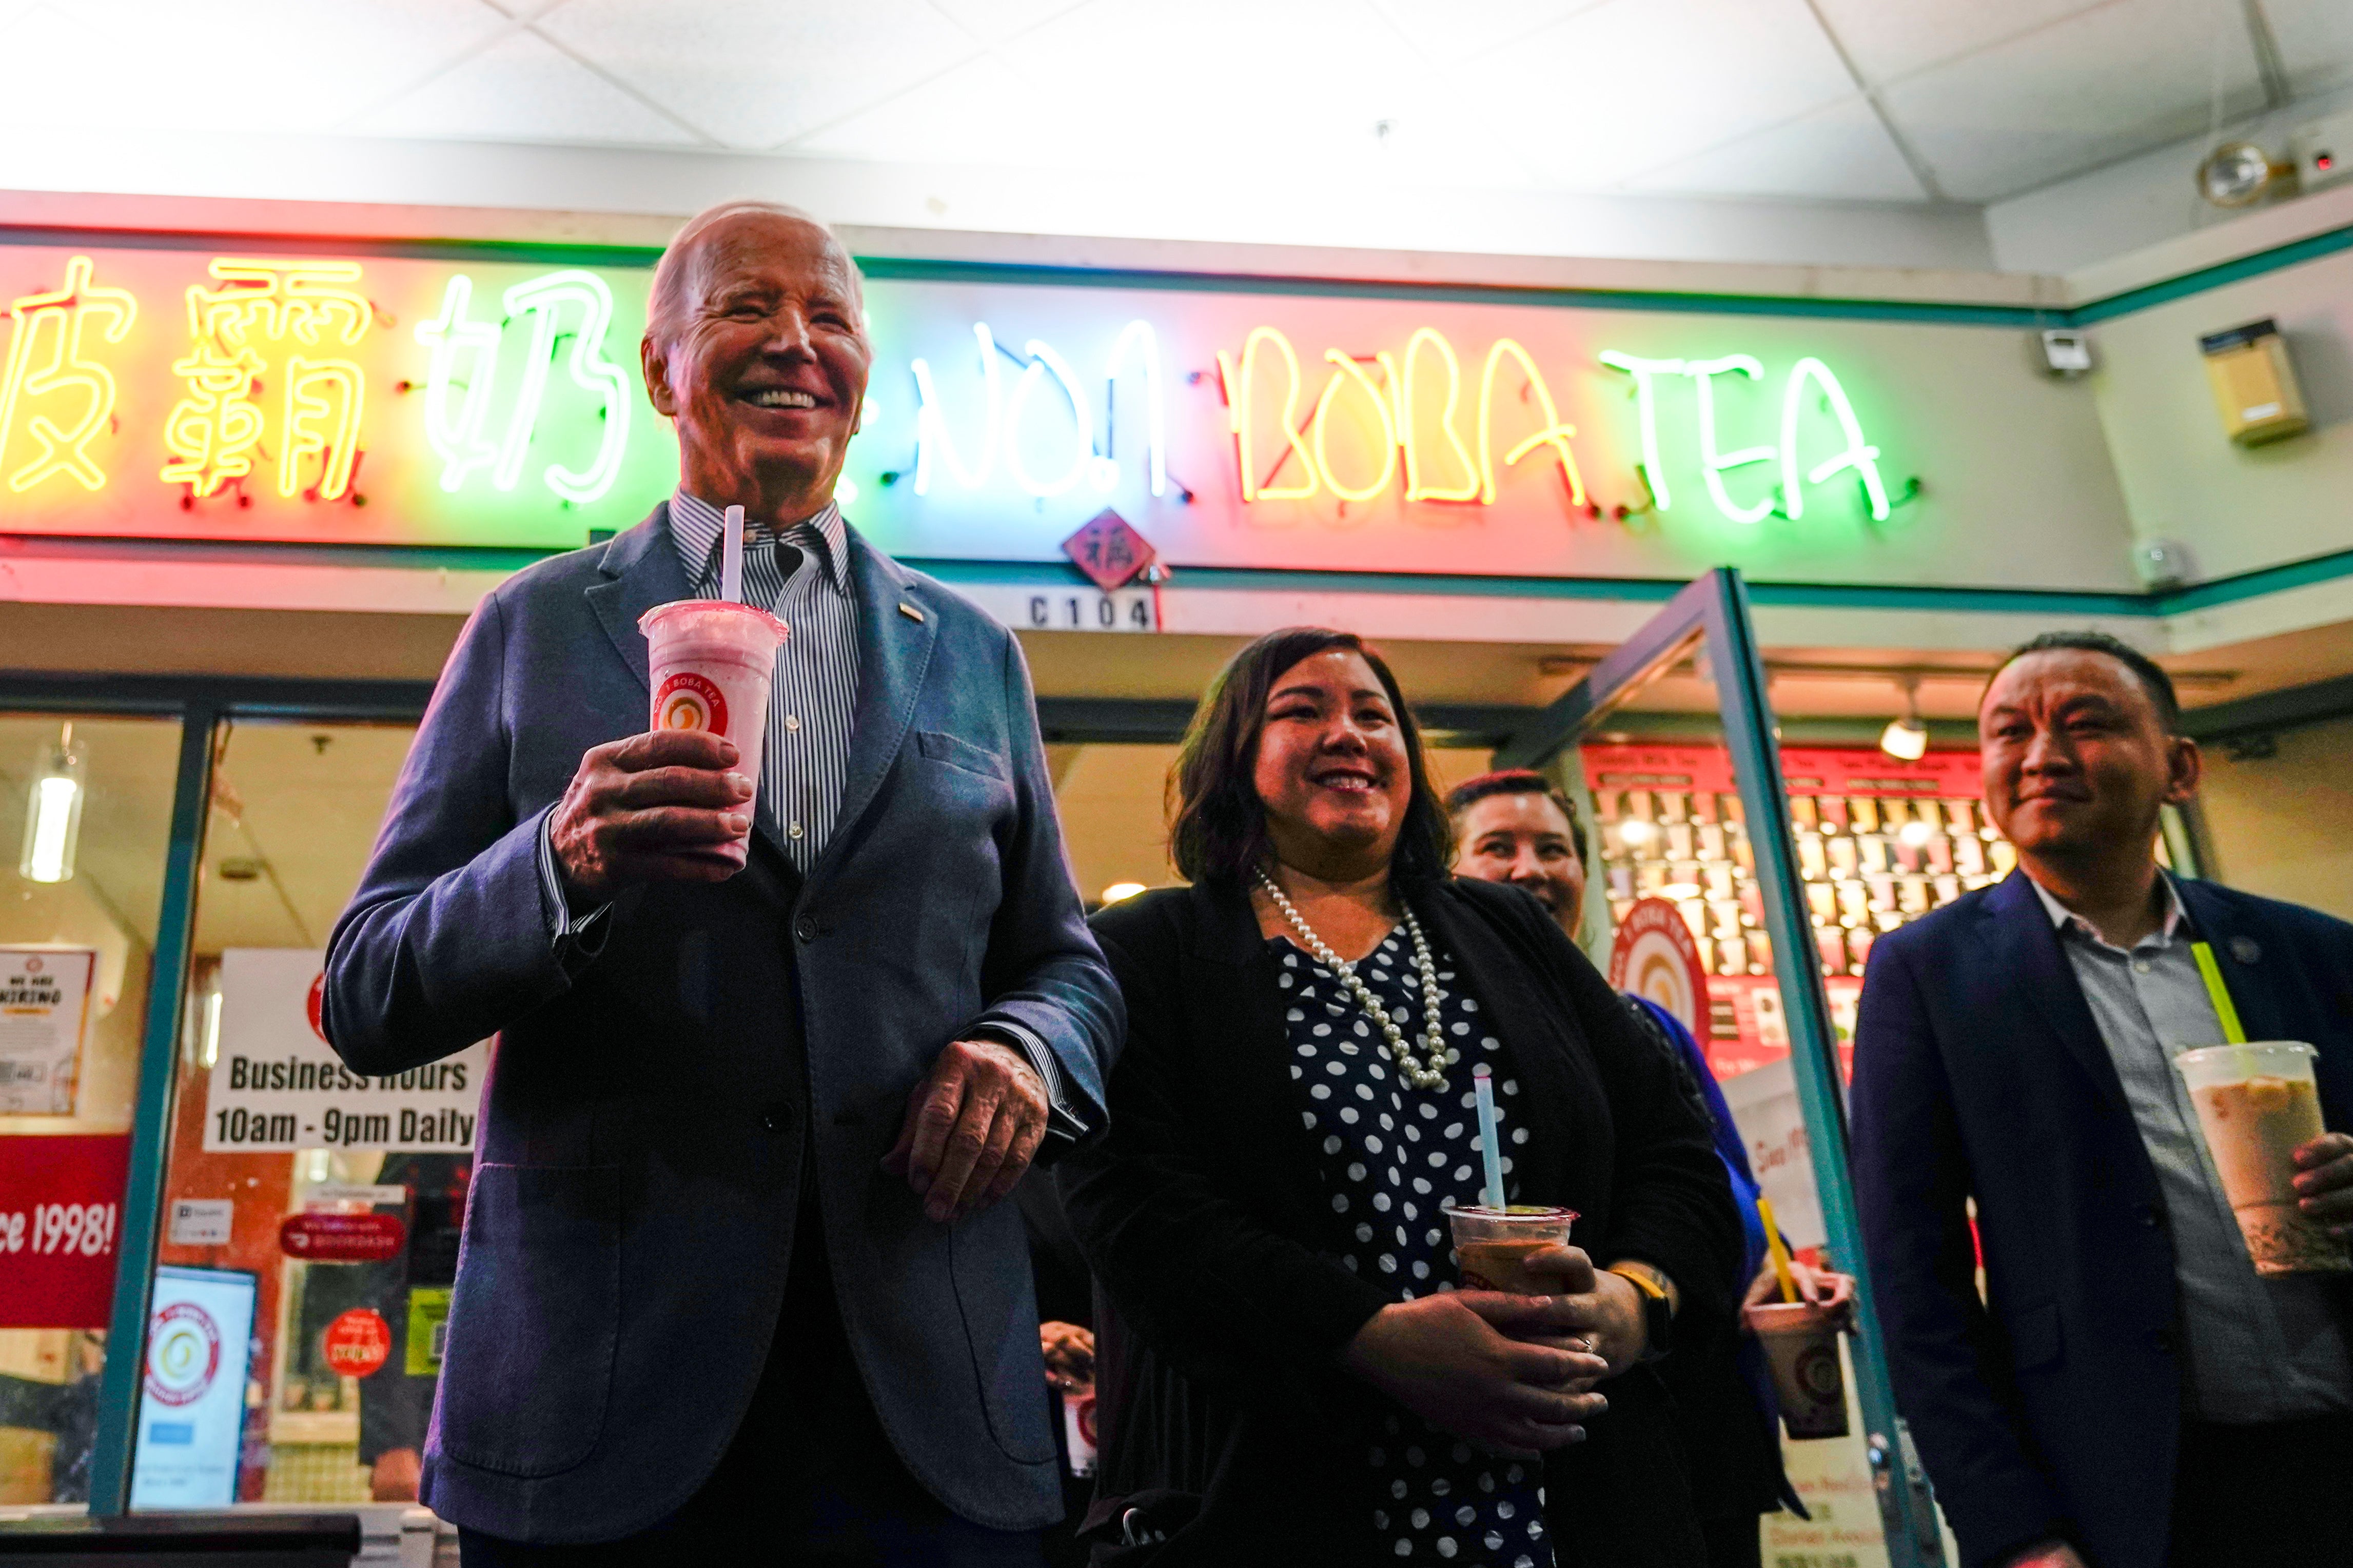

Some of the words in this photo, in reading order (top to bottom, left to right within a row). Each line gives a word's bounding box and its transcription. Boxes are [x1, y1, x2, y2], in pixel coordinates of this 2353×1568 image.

[1217, 325, 1586, 506] BOBA
[1600, 349, 1890, 523] TEA
[673, 677, 702, 689] BOBA
[704, 685, 720, 707] TEA
[217, 1107, 297, 1144] 10am
[324, 1108, 390, 1146] 9pm
[399, 1109, 475, 1146] Daily
[32, 1203, 116, 1257] 1998!
